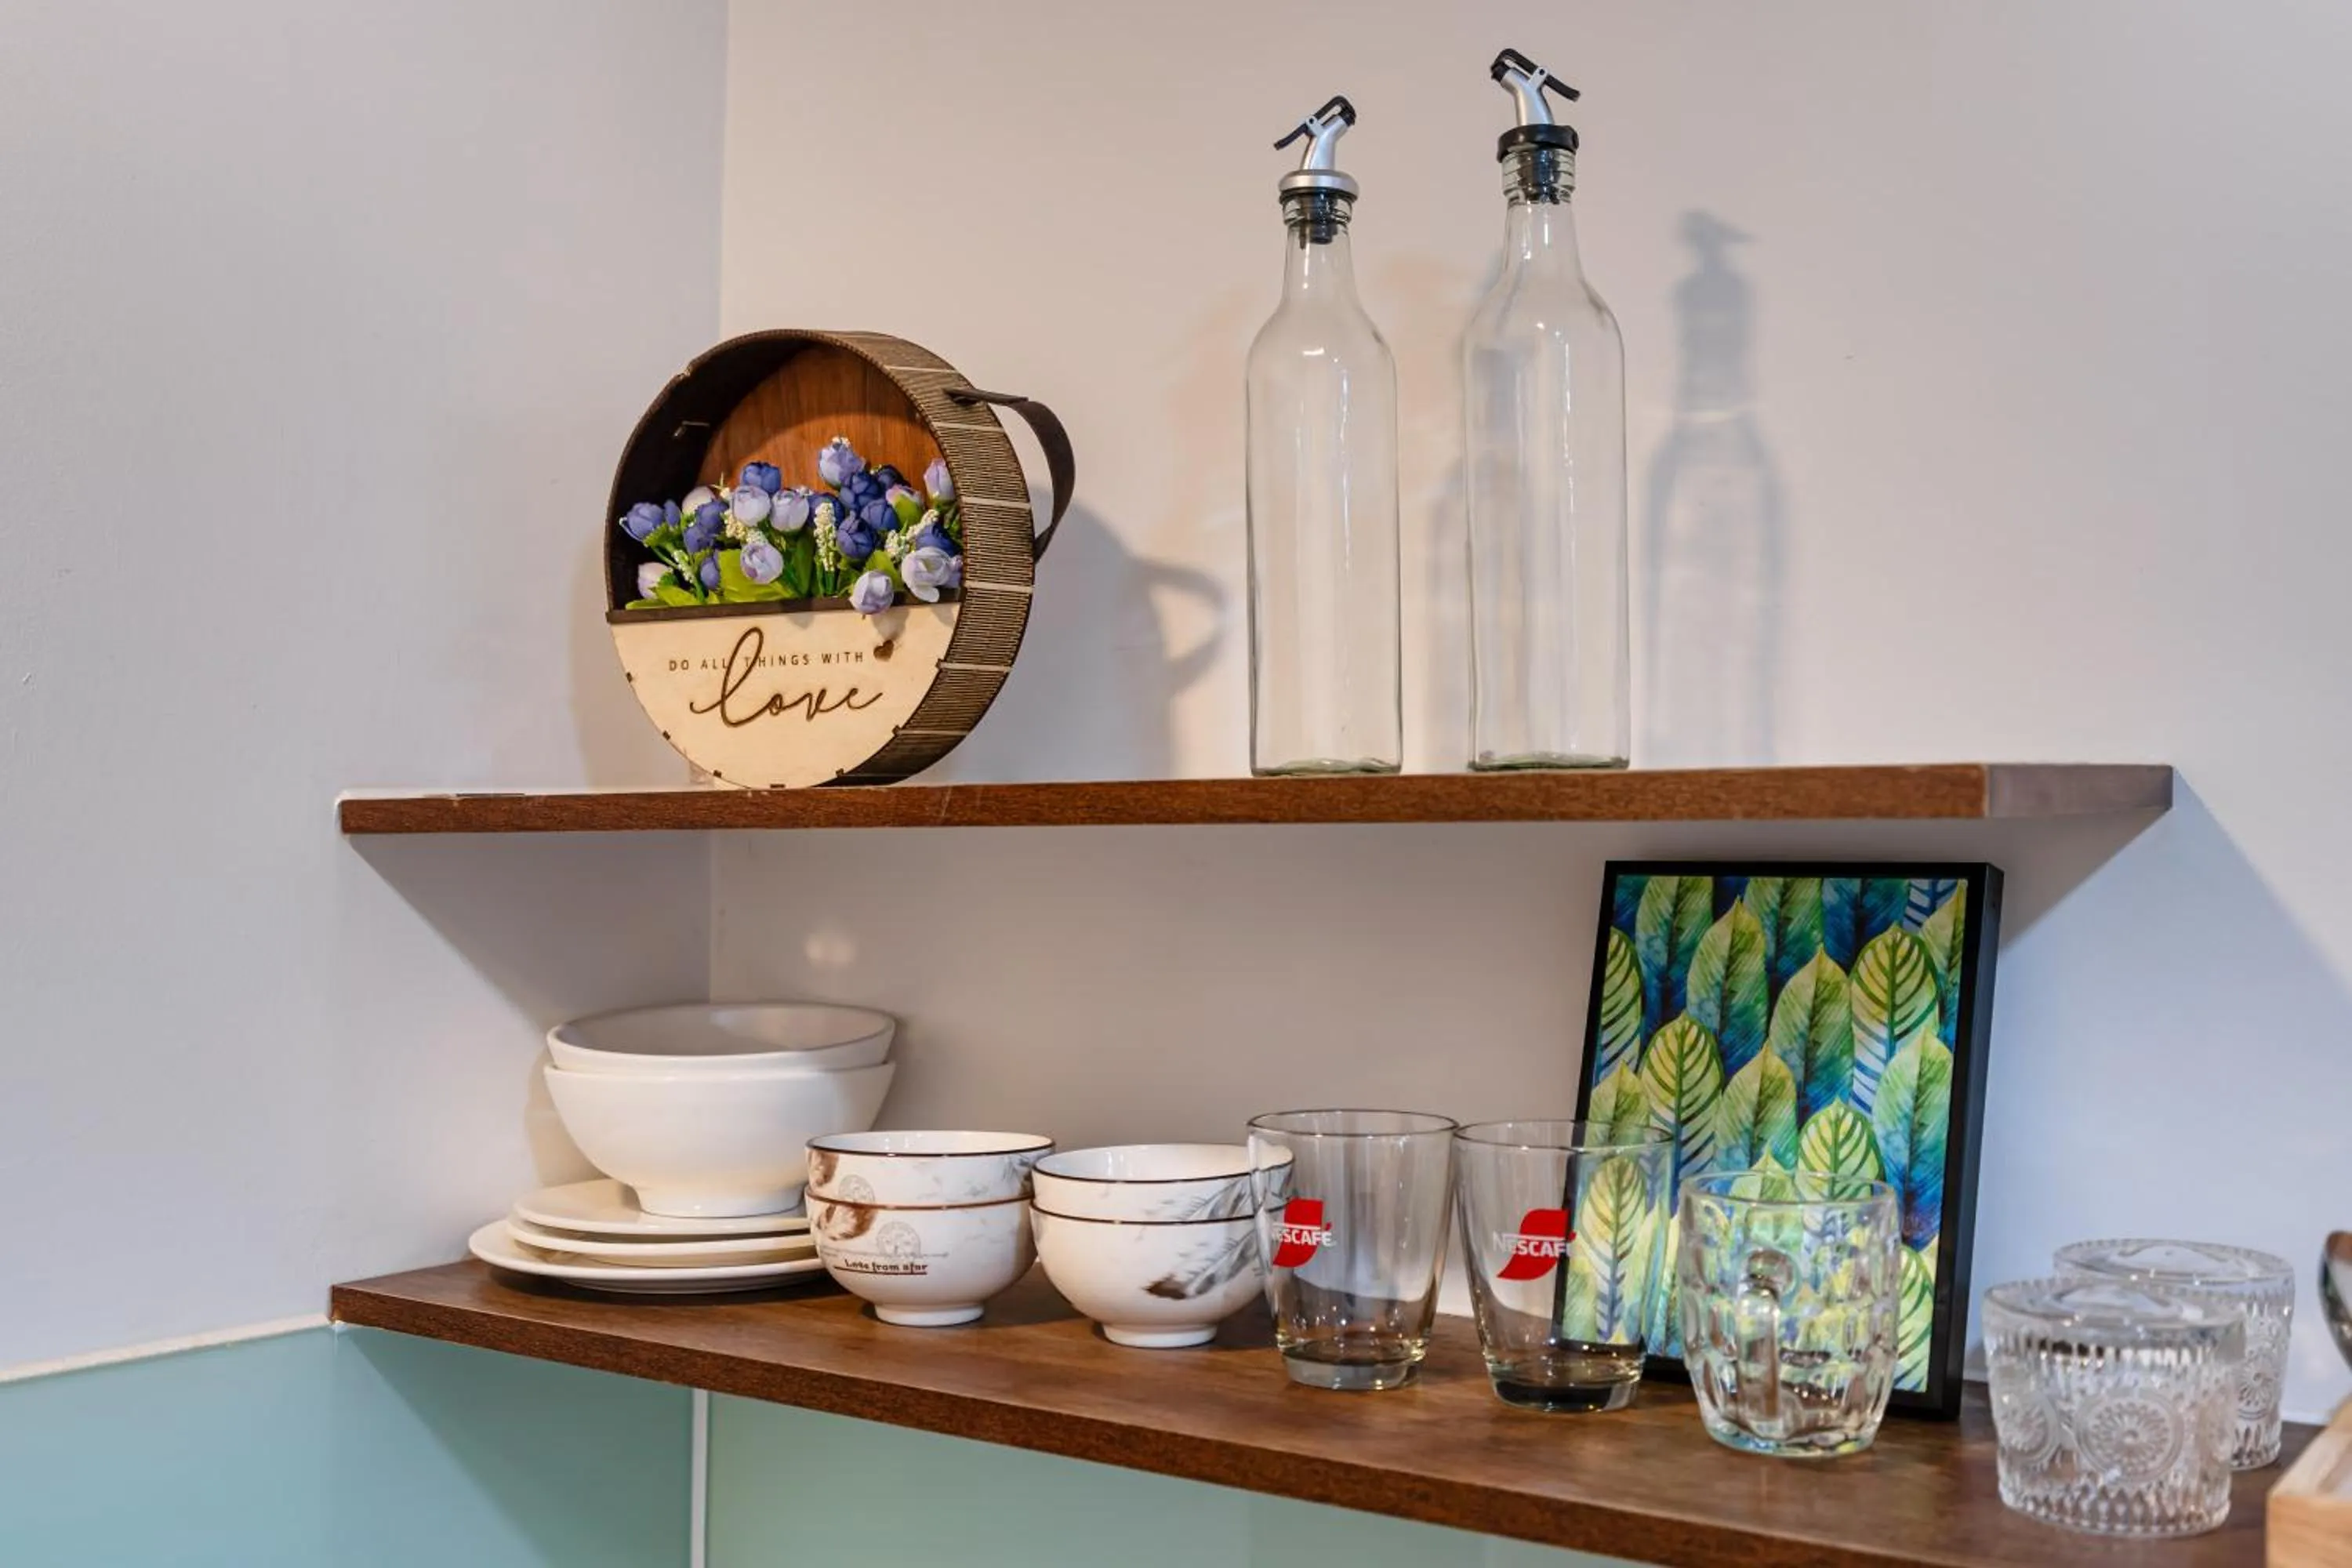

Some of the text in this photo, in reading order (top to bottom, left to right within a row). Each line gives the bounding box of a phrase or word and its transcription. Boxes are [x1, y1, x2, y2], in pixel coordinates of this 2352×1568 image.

[669, 652, 864, 671] DO ALL THINGS WITH
[872, 1261, 900, 1273] from
